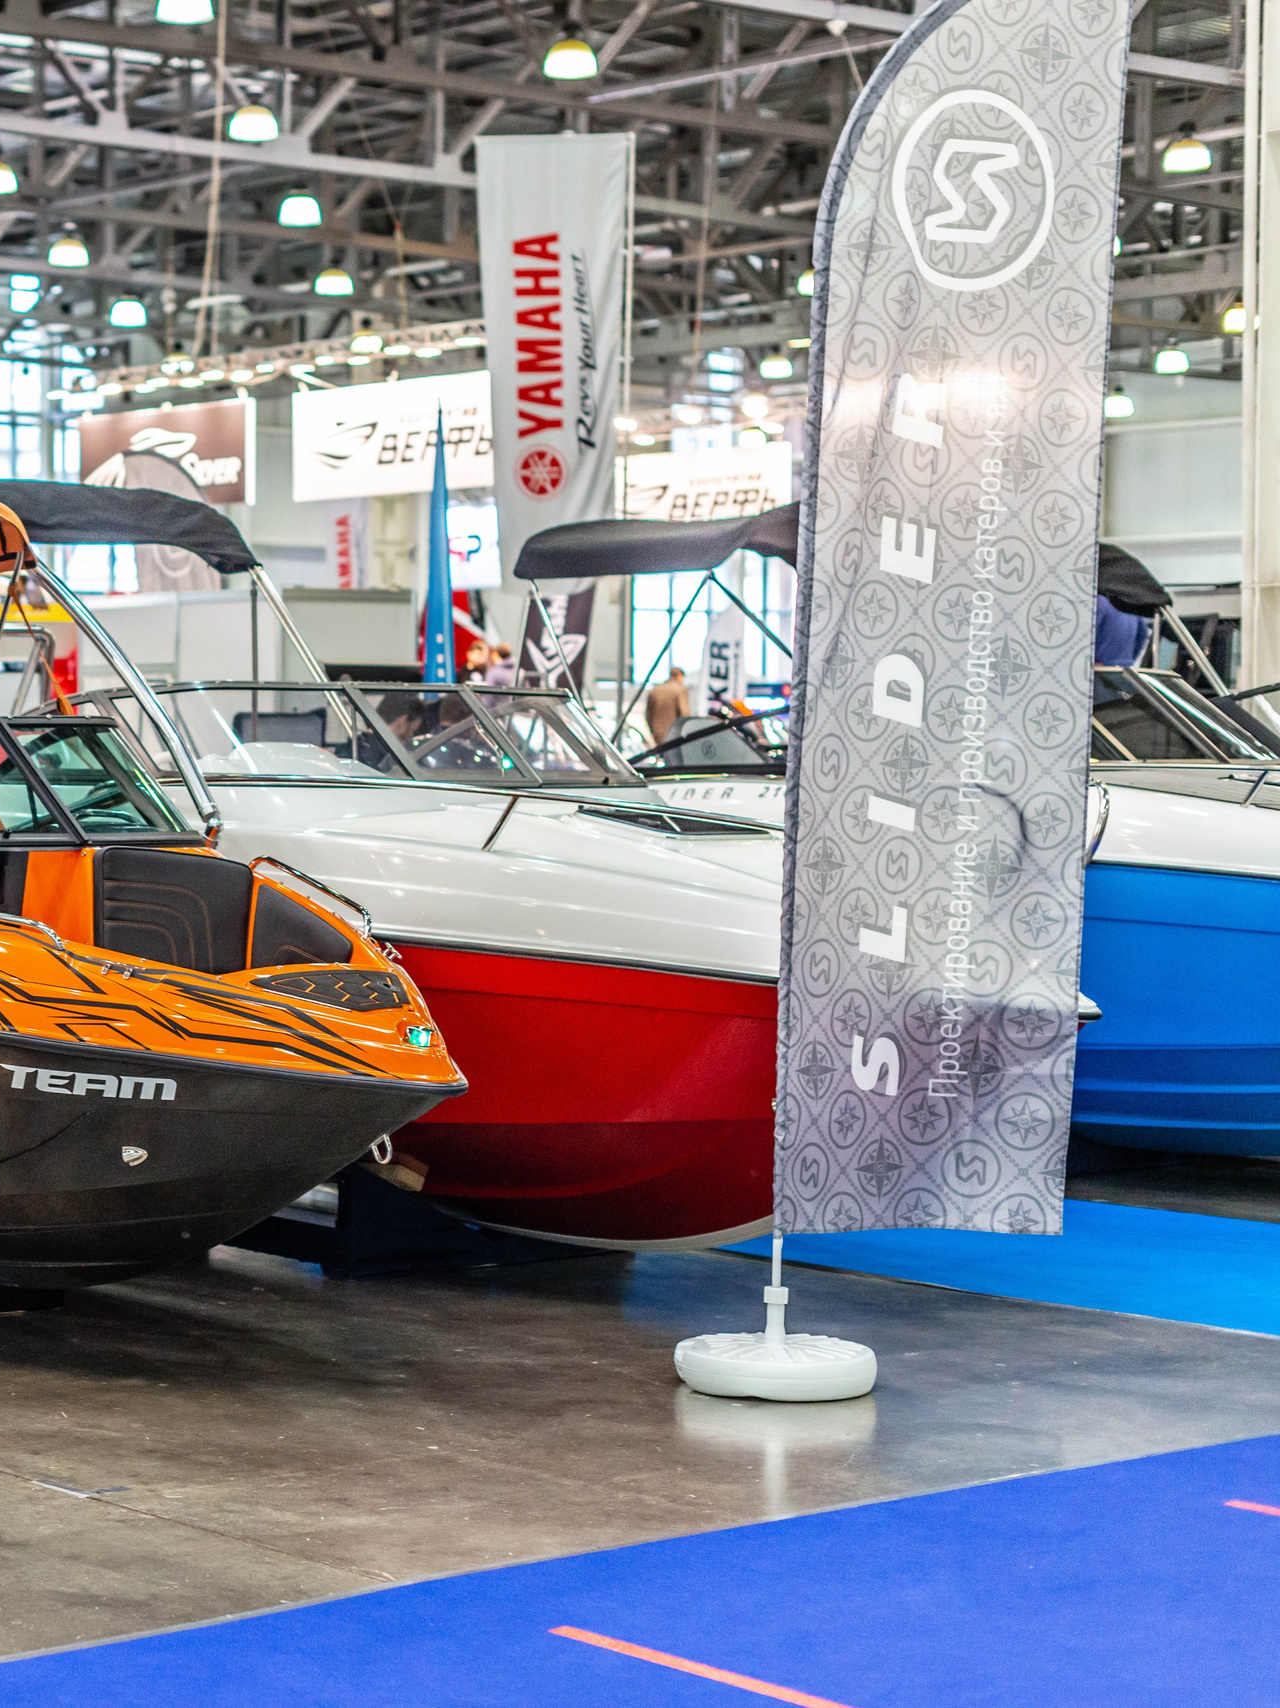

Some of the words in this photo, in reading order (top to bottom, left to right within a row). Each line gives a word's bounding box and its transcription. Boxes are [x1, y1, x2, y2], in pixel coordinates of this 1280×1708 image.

[570, 254, 589, 316] Heart
[513, 232, 564, 439] YAMAHA
[578, 318, 597, 371] Your
[377, 421, 494, 465] ВЕРФЬ
[575, 377, 597, 456] Revs
[983, 430, 1006, 446] и
[334, 513, 352, 589] AMAHA
[974, 459, 1009, 579] катеров
[959, 589, 996, 802] производство
[851, 372, 947, 1097] SLIDER
[758, 785, 787, 799] 21
[957, 815, 980, 831] и
[927, 842, 978, 1098] Проектирование
[0, 1062, 177, 1101] TEAM
